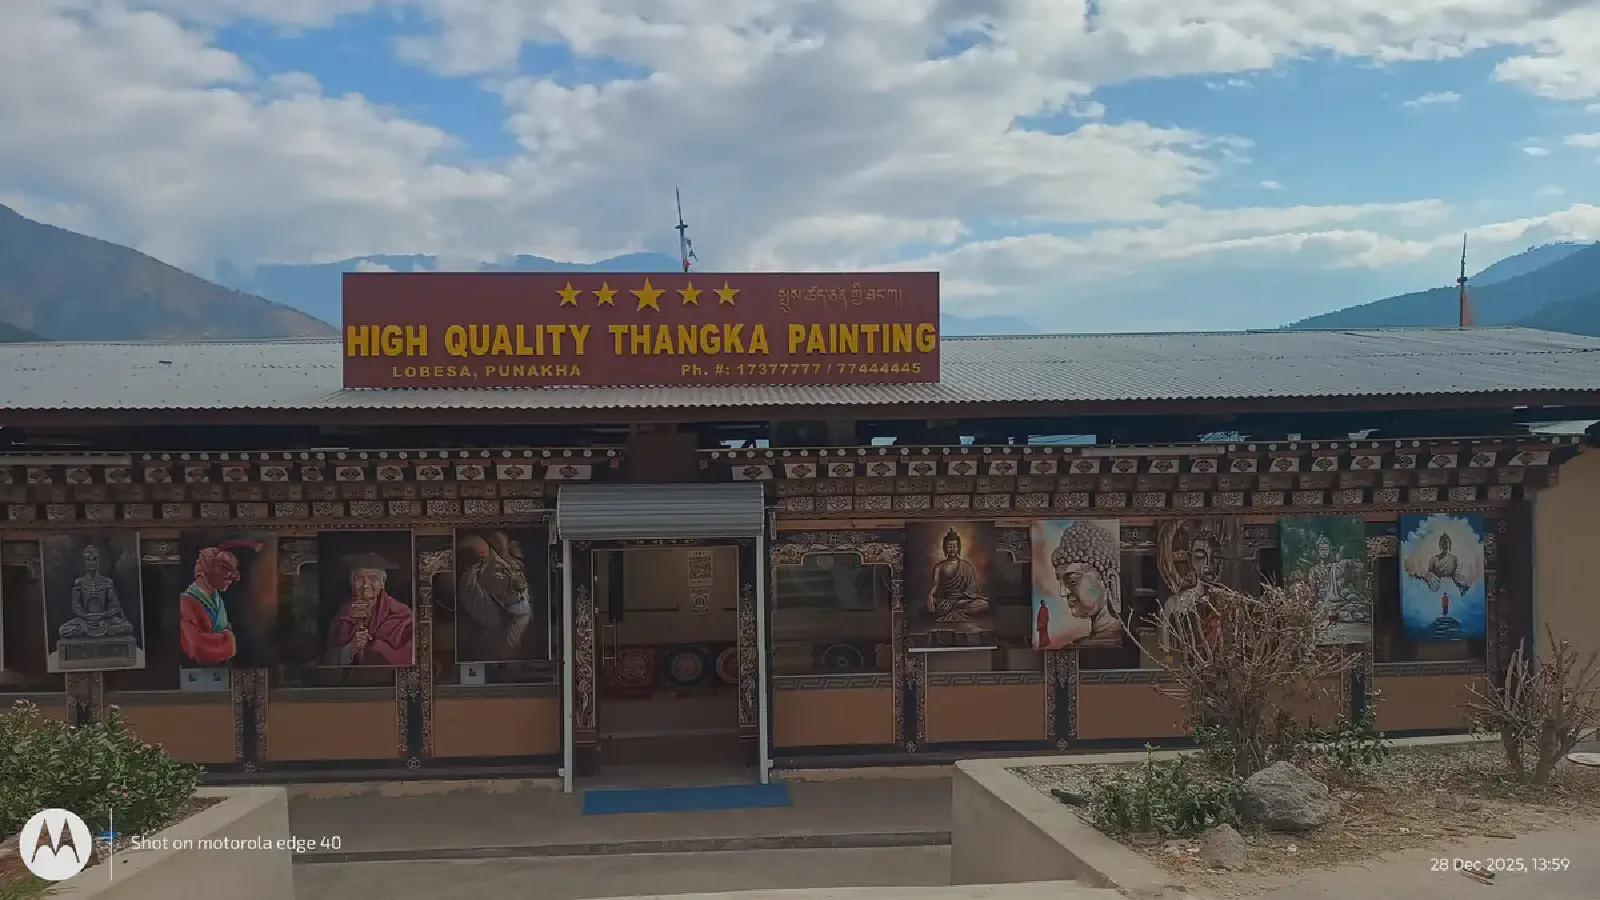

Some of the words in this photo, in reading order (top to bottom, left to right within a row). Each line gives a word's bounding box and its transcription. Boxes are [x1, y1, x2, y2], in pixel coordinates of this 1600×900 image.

[347, 325, 428, 357] HIGH
[444, 324, 590, 357] QUALITY
[608, 323, 769, 355] THANGKA
[788, 322, 936, 354] PAINTING
[392, 365, 478, 379] LOBESA,
[484, 364, 582, 377] PUNAKHA
[681, 363, 709, 376] Ph.
[715, 364, 730, 376] #:
[736, 363, 821, 376] 17377777
[836, 362, 921, 374] 77444445
